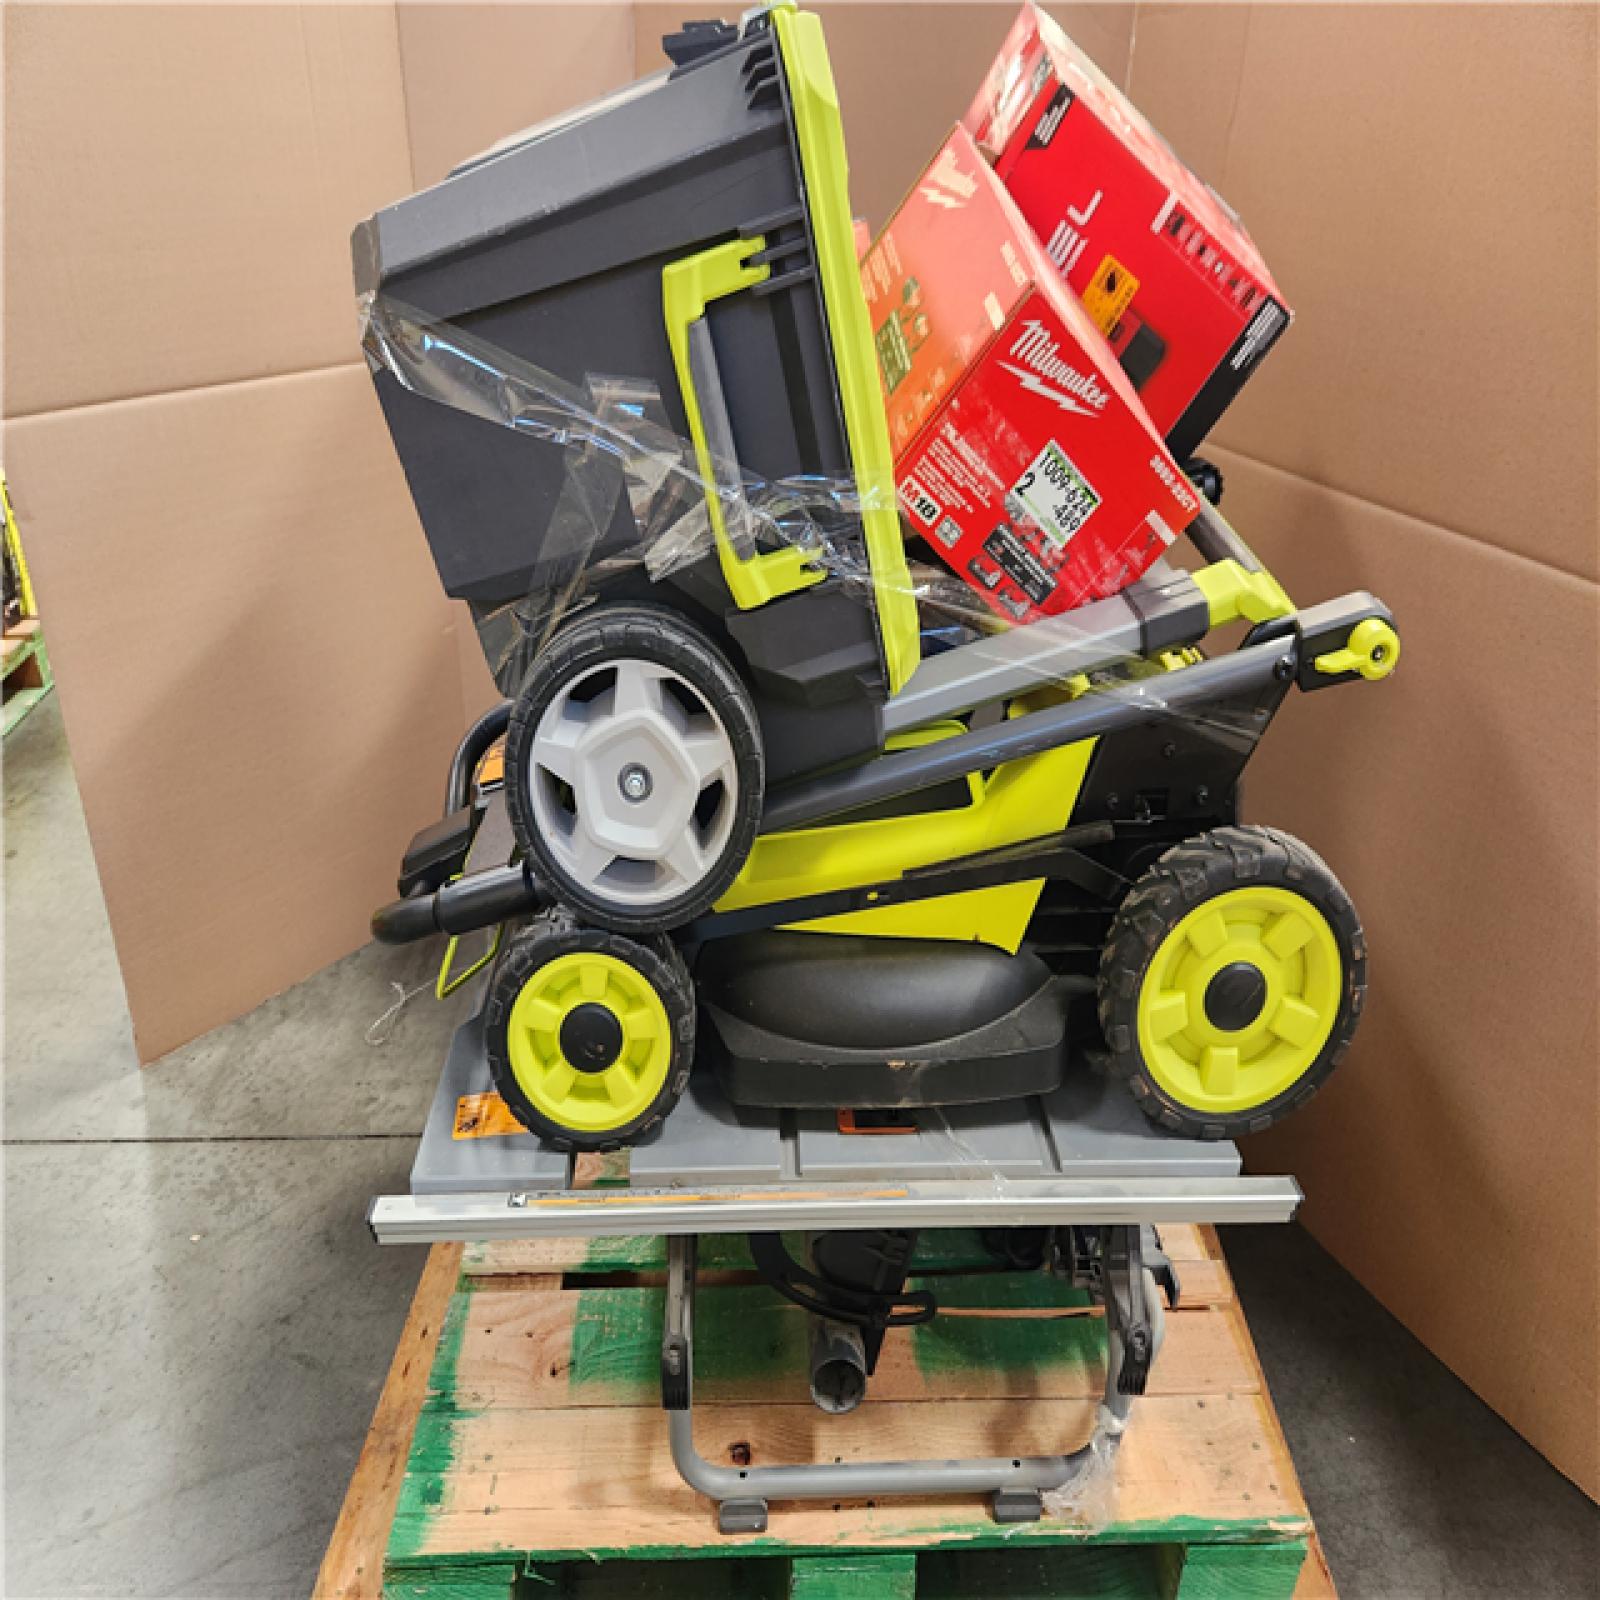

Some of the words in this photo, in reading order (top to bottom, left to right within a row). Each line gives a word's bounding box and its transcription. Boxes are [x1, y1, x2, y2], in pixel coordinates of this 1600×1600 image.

[1047, 189, 1103, 277] EL
[1009, 319, 1108, 410] Milwaukee
[901, 481, 938, 519] M18
[1014, 472, 1035, 497] 2
